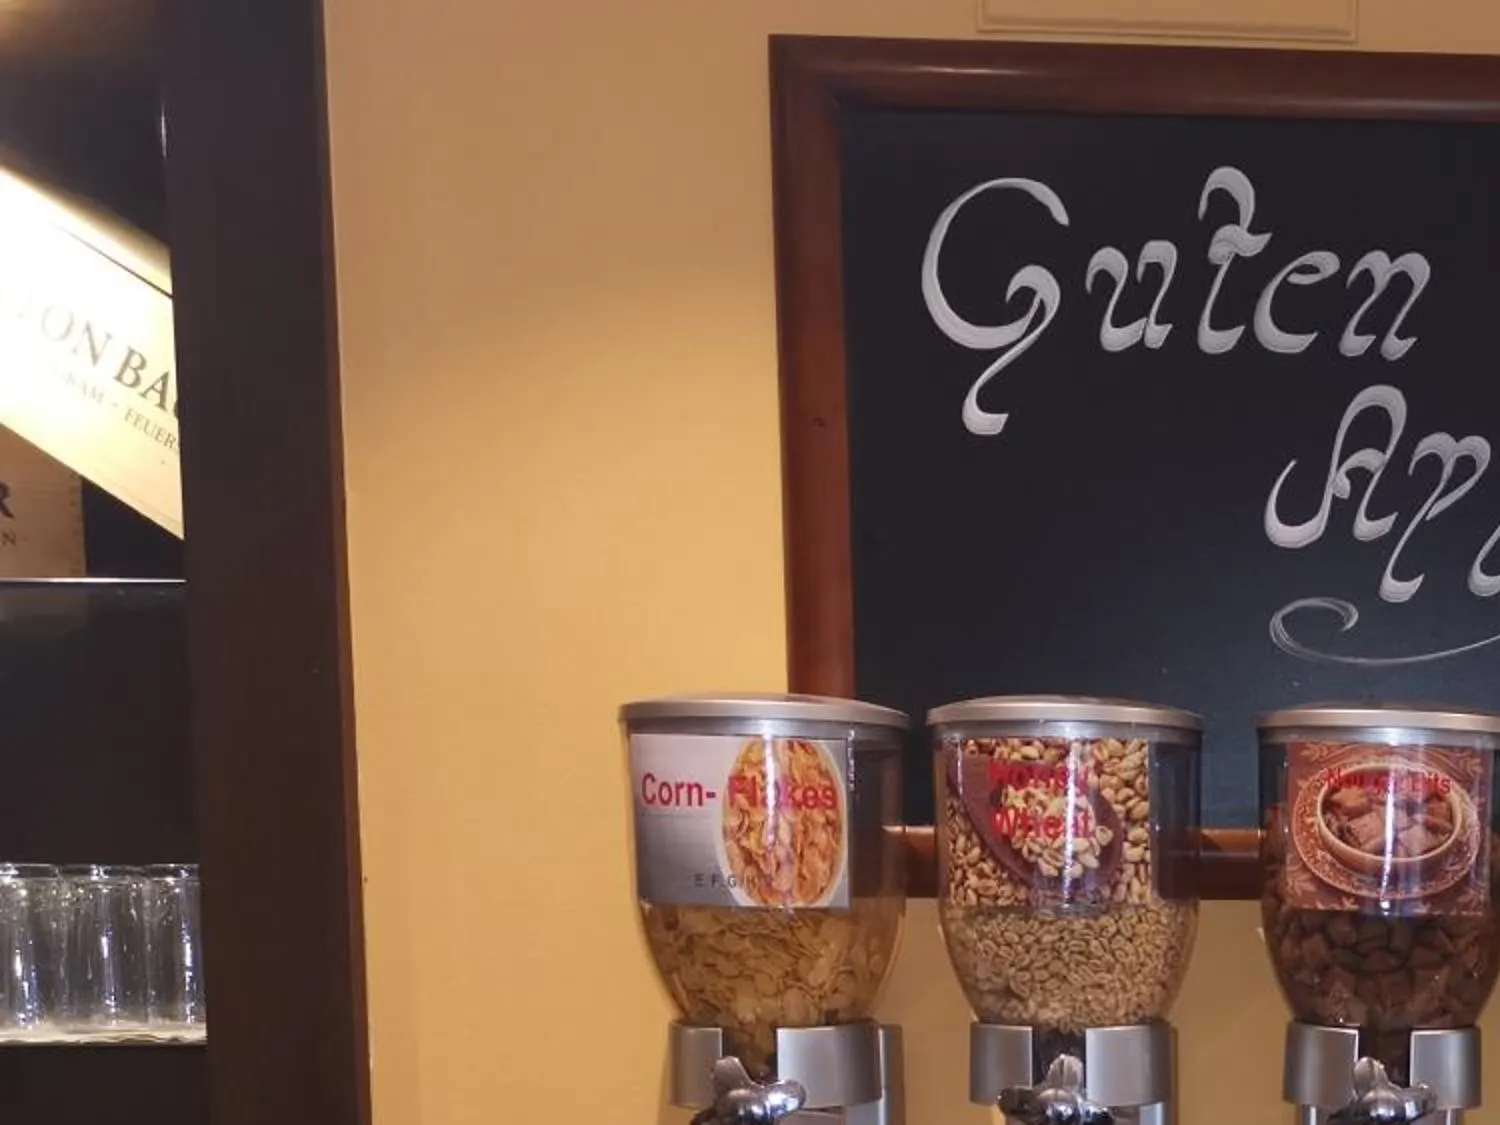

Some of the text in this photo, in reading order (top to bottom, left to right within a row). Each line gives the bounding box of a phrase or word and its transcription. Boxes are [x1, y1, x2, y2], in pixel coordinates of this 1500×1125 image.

[920, 166, 1430, 434] Guten
[113, 345, 180, 420] BA
[123, 406, 180, 457] FEUER
[641, 772, 717, 807] Corn-
